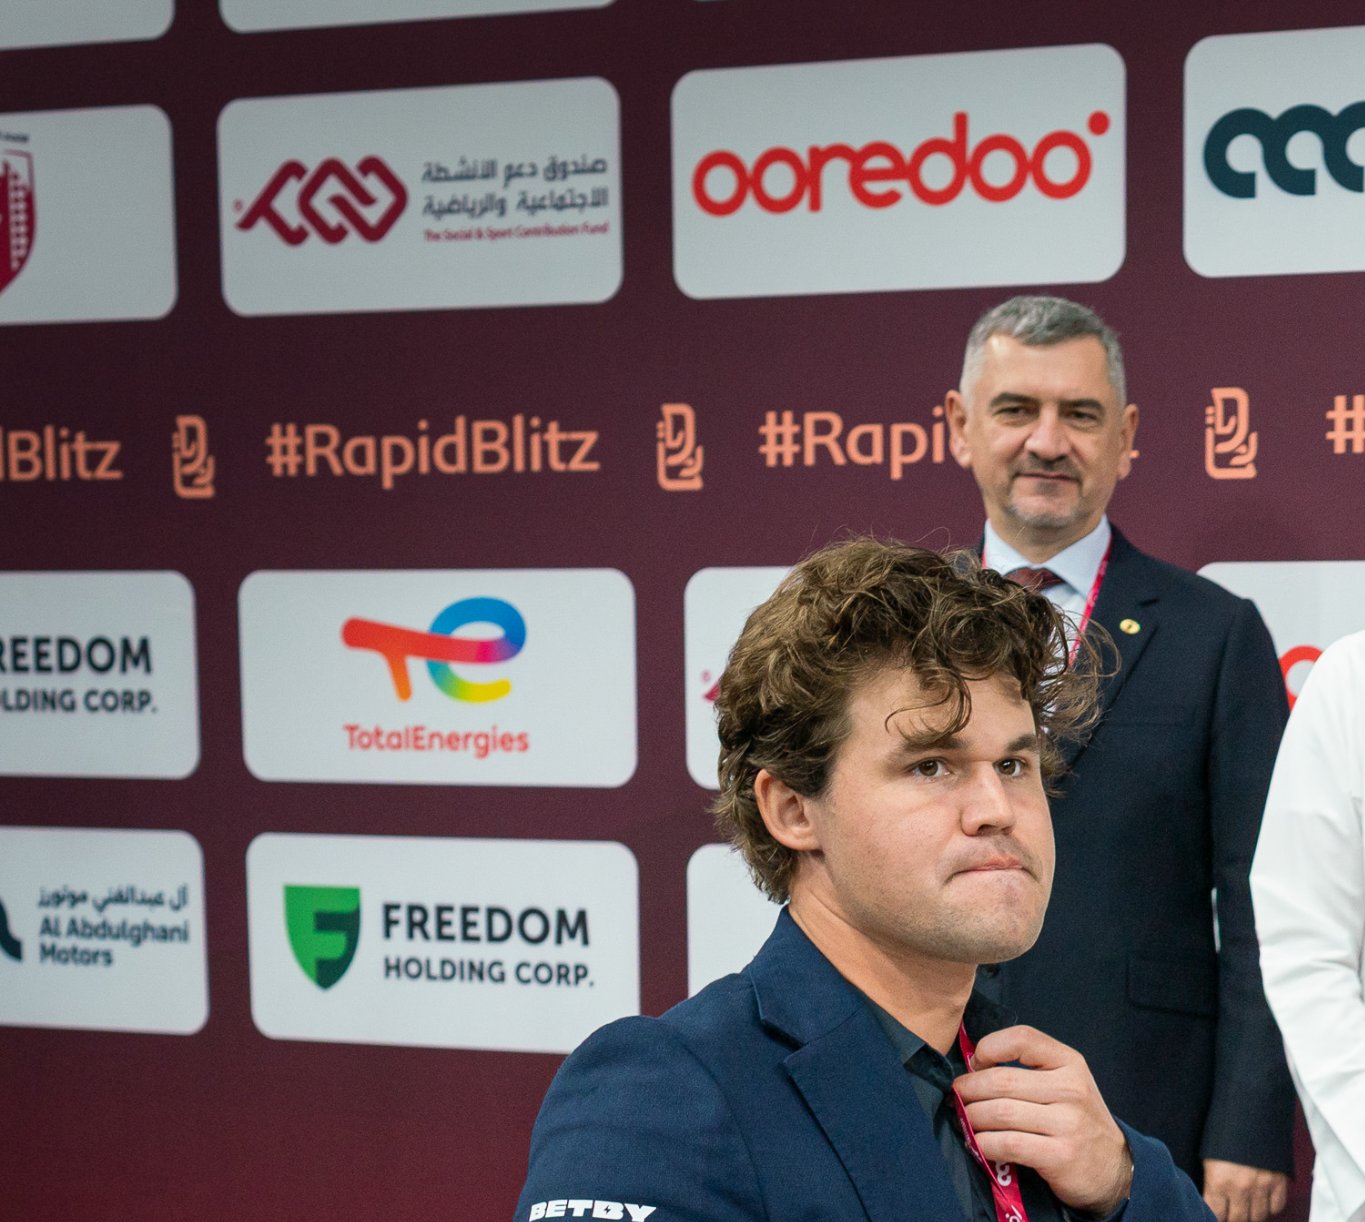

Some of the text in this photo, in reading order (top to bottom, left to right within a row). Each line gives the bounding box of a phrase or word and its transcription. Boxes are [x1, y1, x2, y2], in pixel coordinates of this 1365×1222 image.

[692, 110, 1111, 217] ooredoo
[0, 425, 122, 482] Blitz
[265, 413, 600, 491] #RapidBlitz
[758, 405, 947, 480] #Rapi
[84, 688, 158, 713] CORP.
[343, 723, 531, 760] TotalEnergies
[40, 916, 190, 948] Al Abdulghani
[382, 902, 590, 948] FREEDOM
[39, 942, 113, 967] Motors
[384, 956, 595, 989] HOLDING CORP.
